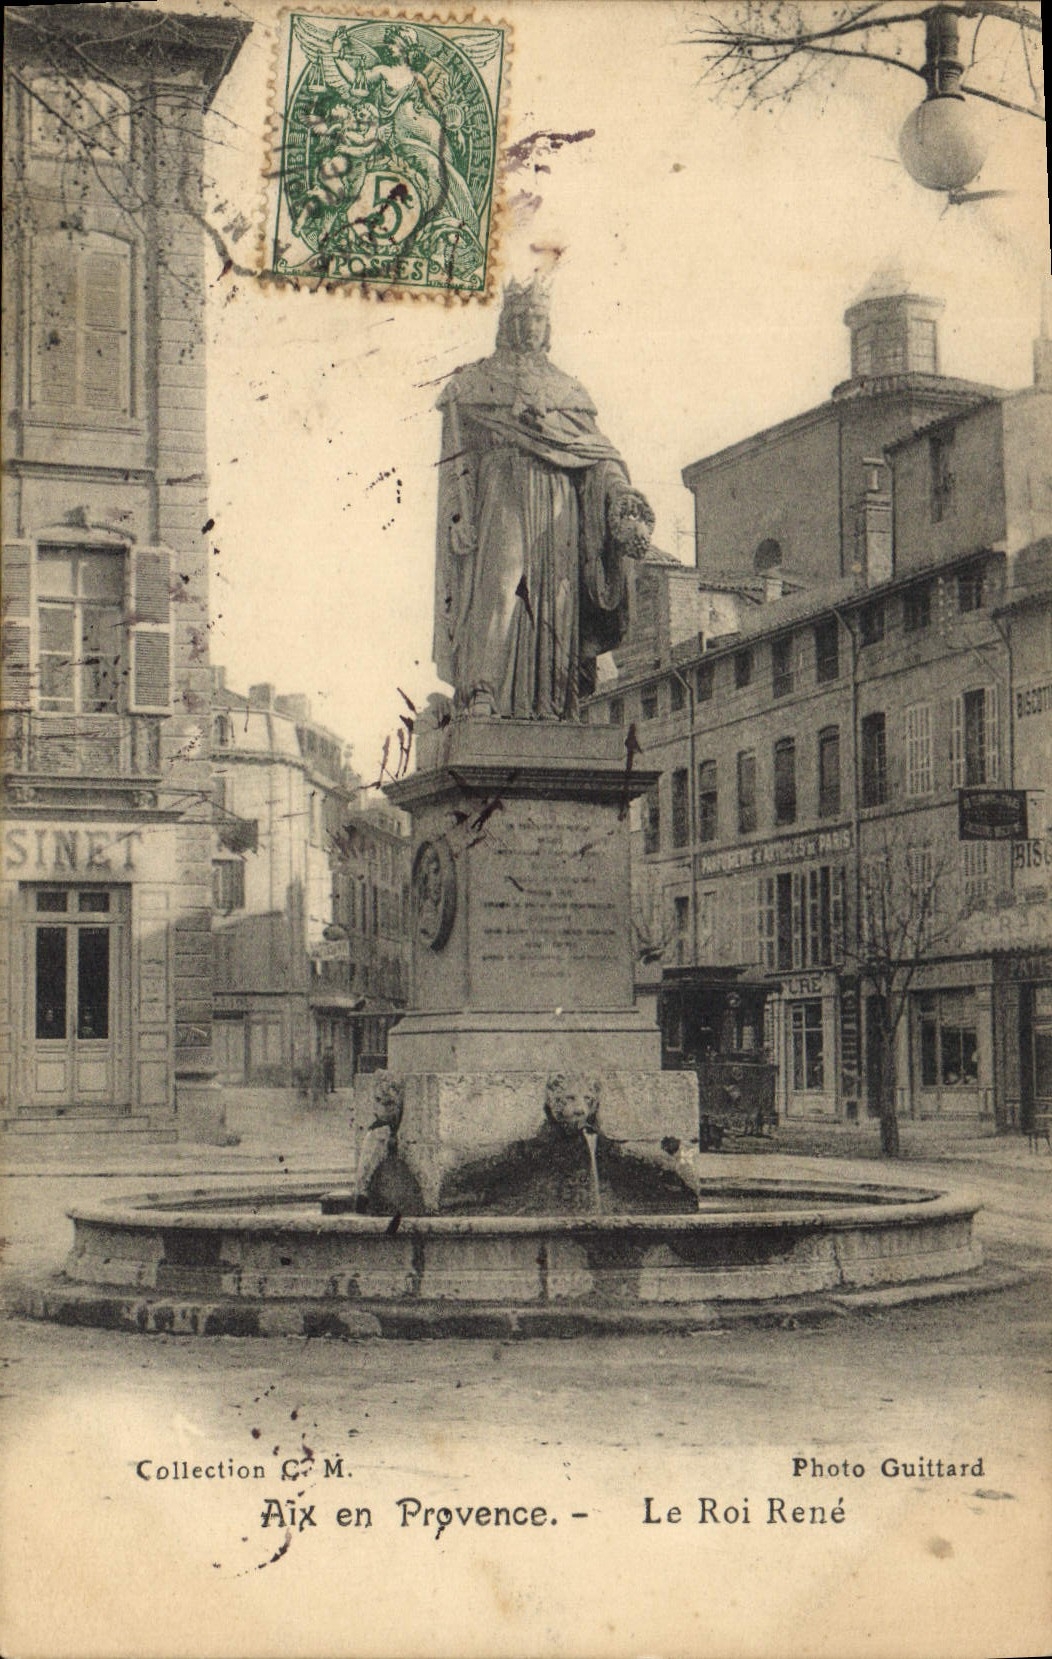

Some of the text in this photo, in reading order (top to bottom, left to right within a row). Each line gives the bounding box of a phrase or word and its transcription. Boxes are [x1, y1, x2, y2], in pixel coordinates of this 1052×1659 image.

[332, 254, 423, 281] POSTES
[5, 828, 142, 871] SINET
[819, 829, 850, 853] PARIS
